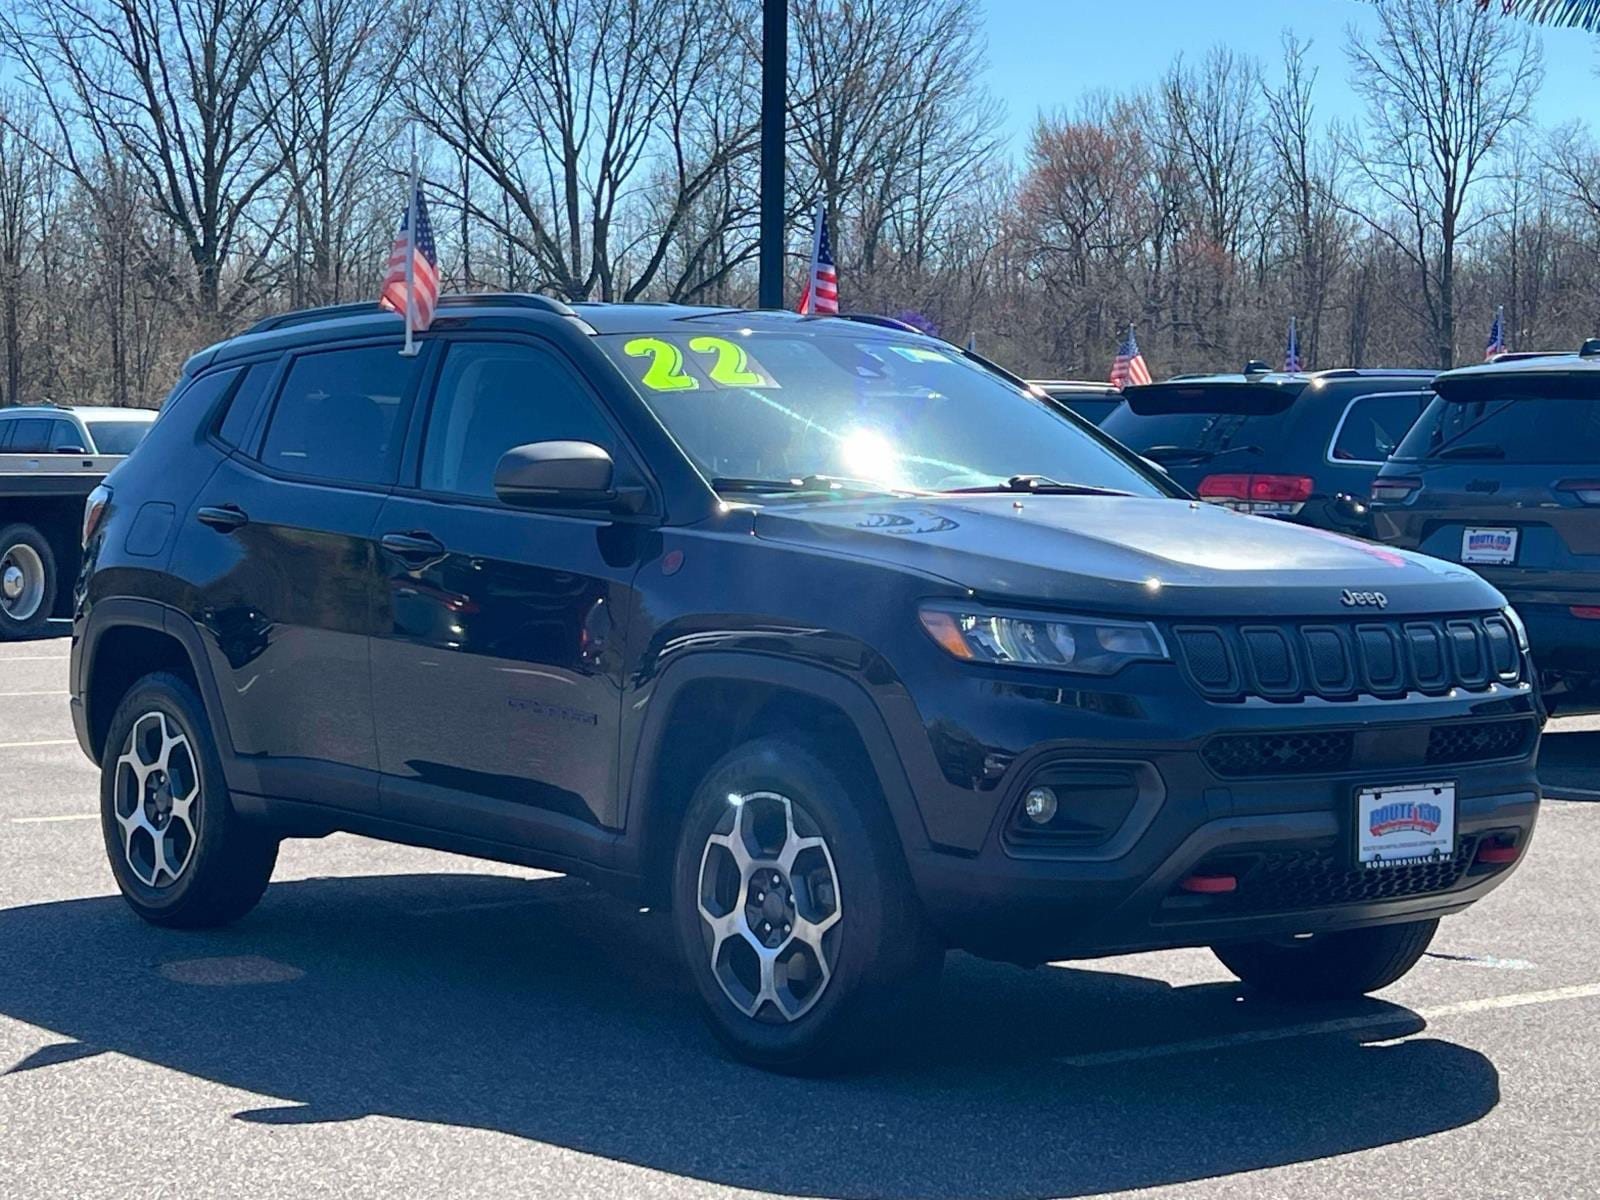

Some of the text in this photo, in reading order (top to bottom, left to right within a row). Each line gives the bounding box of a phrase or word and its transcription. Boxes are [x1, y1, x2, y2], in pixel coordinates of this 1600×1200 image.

[624, 336, 766, 392] 22
[1340, 588, 1388, 608] Jeep
[1370, 802, 1441, 828] ROUTE 130
